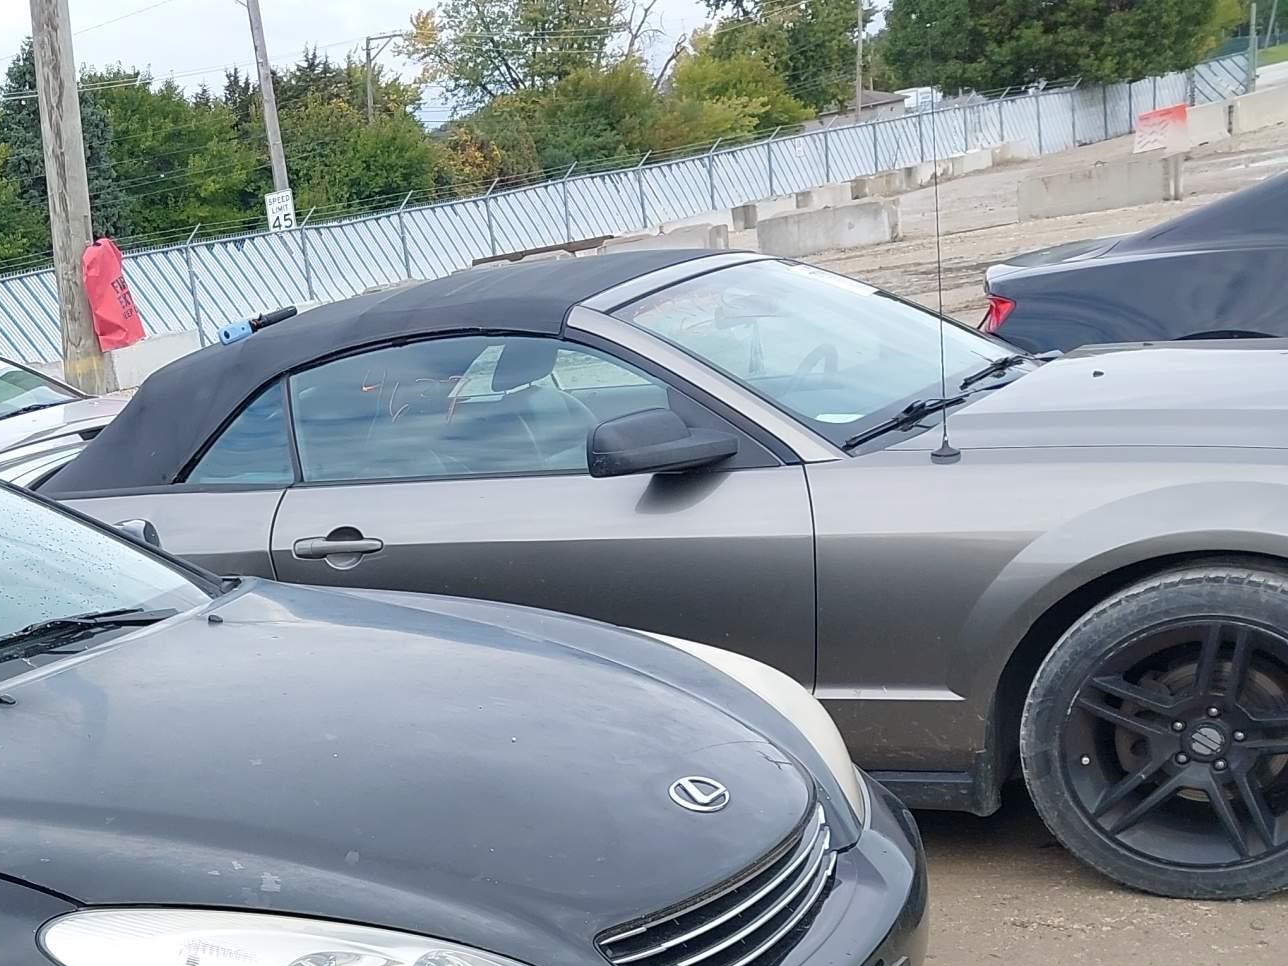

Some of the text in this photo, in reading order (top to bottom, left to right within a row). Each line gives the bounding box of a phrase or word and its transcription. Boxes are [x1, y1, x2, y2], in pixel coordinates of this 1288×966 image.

[268, 194, 290, 206] SPEED
[272, 203, 289, 215] LIMIT
[272, 213, 293, 230] 45
[111, 275, 128, 294] FIR
